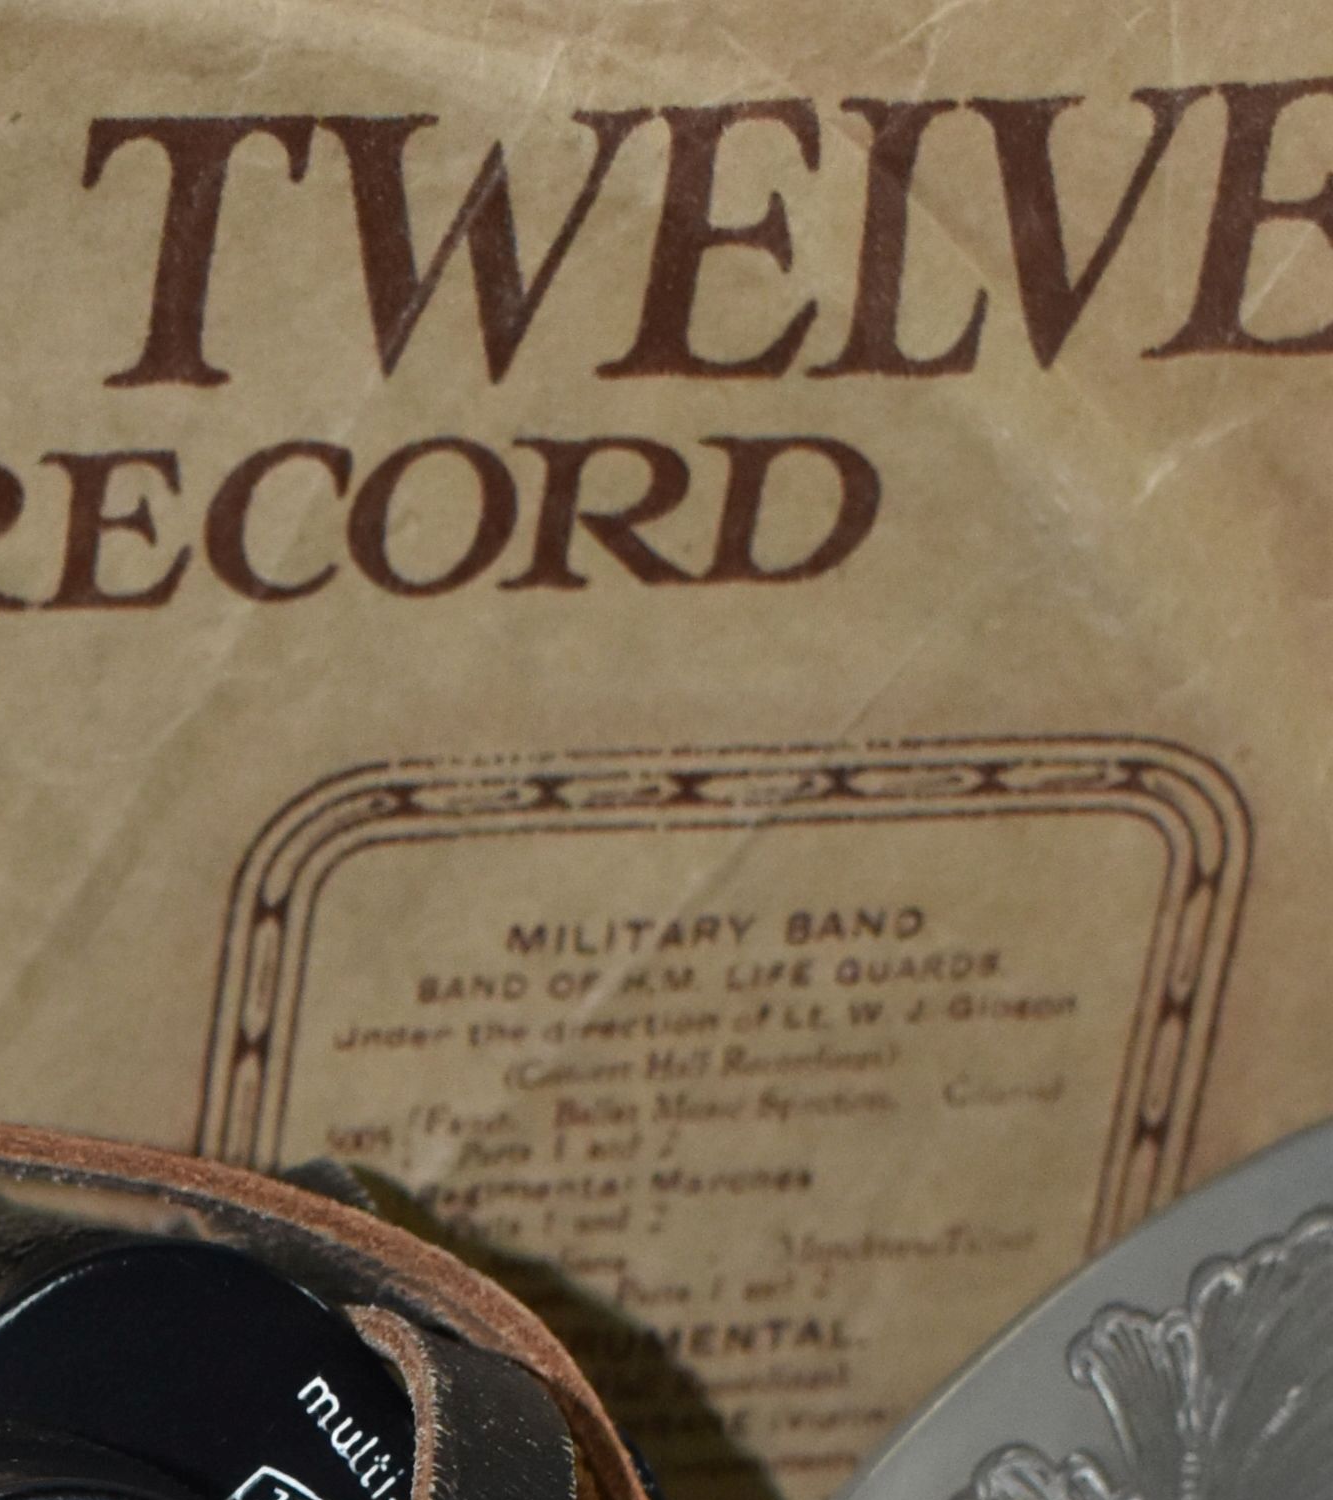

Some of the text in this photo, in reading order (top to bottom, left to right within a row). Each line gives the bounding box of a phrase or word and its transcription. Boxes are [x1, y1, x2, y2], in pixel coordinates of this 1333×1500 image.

[81, 76, 1333, 388] TWELVE
[506, 906, 925, 956] MILITARY BAND
[416, 972, 529, 1004] BAND
